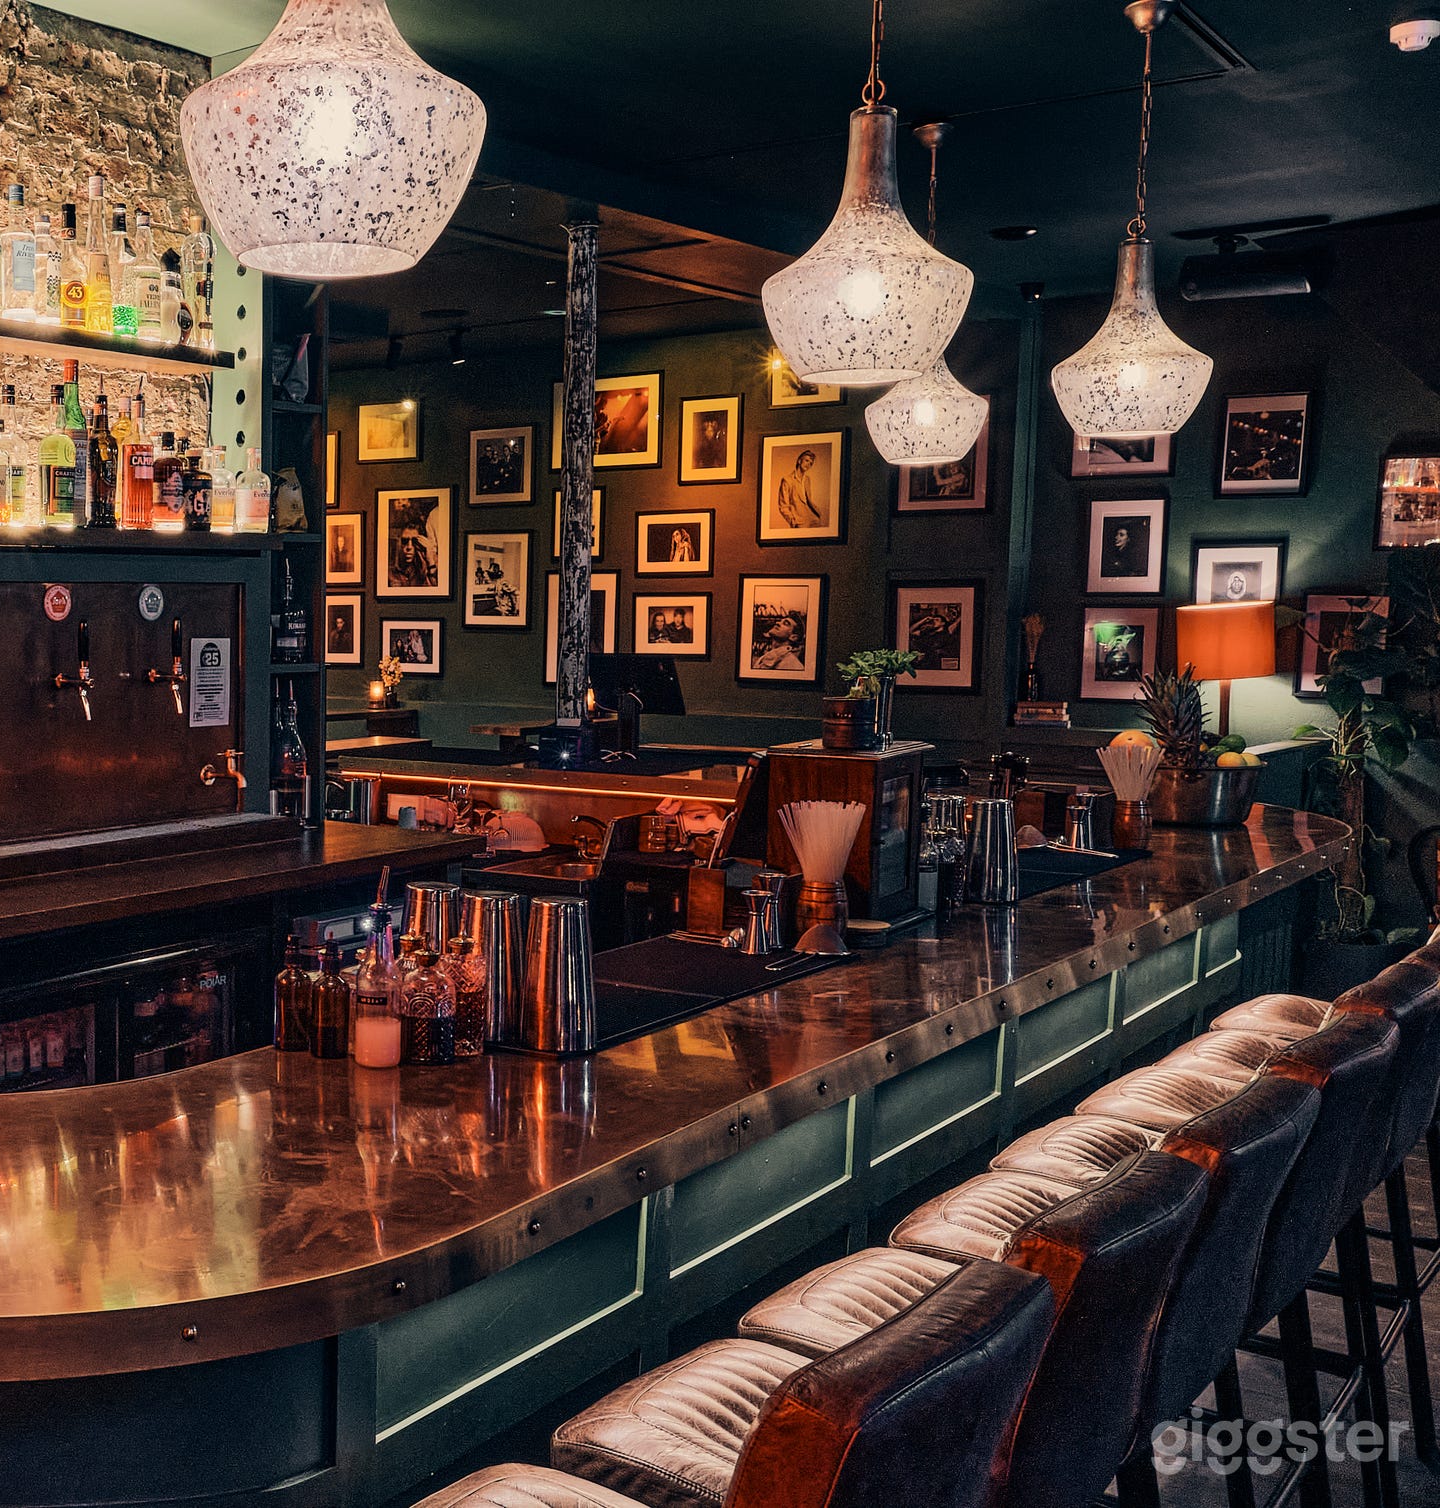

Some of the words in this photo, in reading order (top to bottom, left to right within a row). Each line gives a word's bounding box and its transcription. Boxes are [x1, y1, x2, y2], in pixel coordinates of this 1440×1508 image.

[67, 285, 83, 299] 43
[205, 652, 219, 666] 25
[200, 975, 227, 990] POLAR
